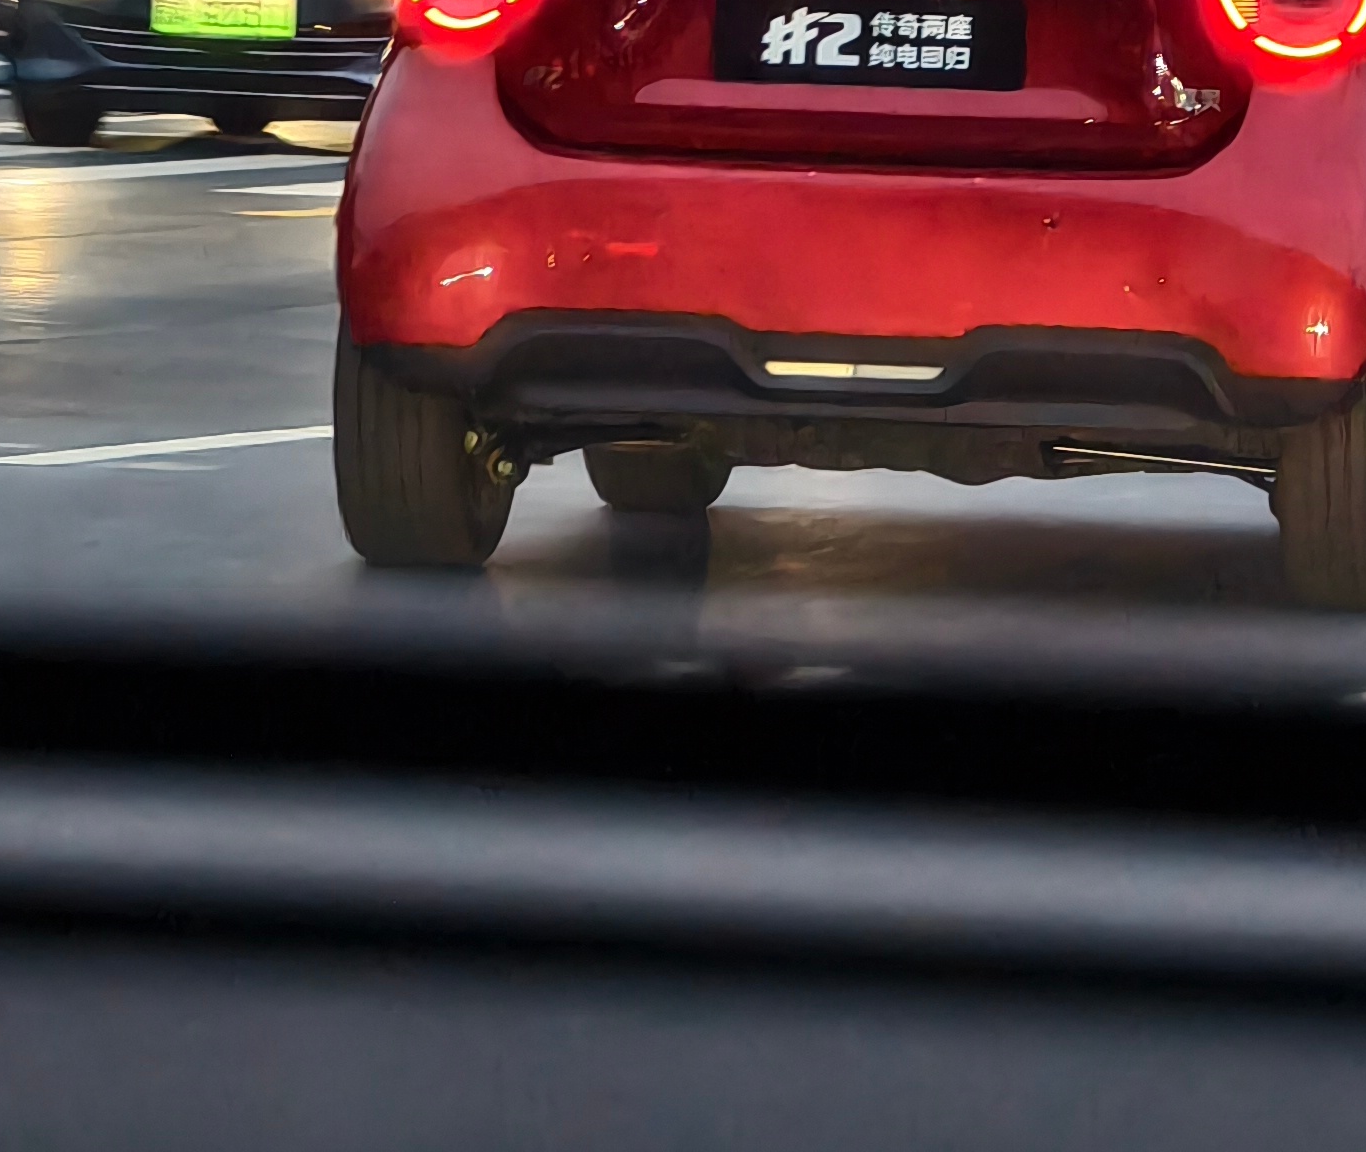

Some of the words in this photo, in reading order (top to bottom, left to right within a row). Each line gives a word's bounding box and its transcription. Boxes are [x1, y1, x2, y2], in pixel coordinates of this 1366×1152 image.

[760, 6, 863, 67] #2
[868, 11, 974, 40] 传奇两座
[867, 41, 971, 70] 纯电回归
